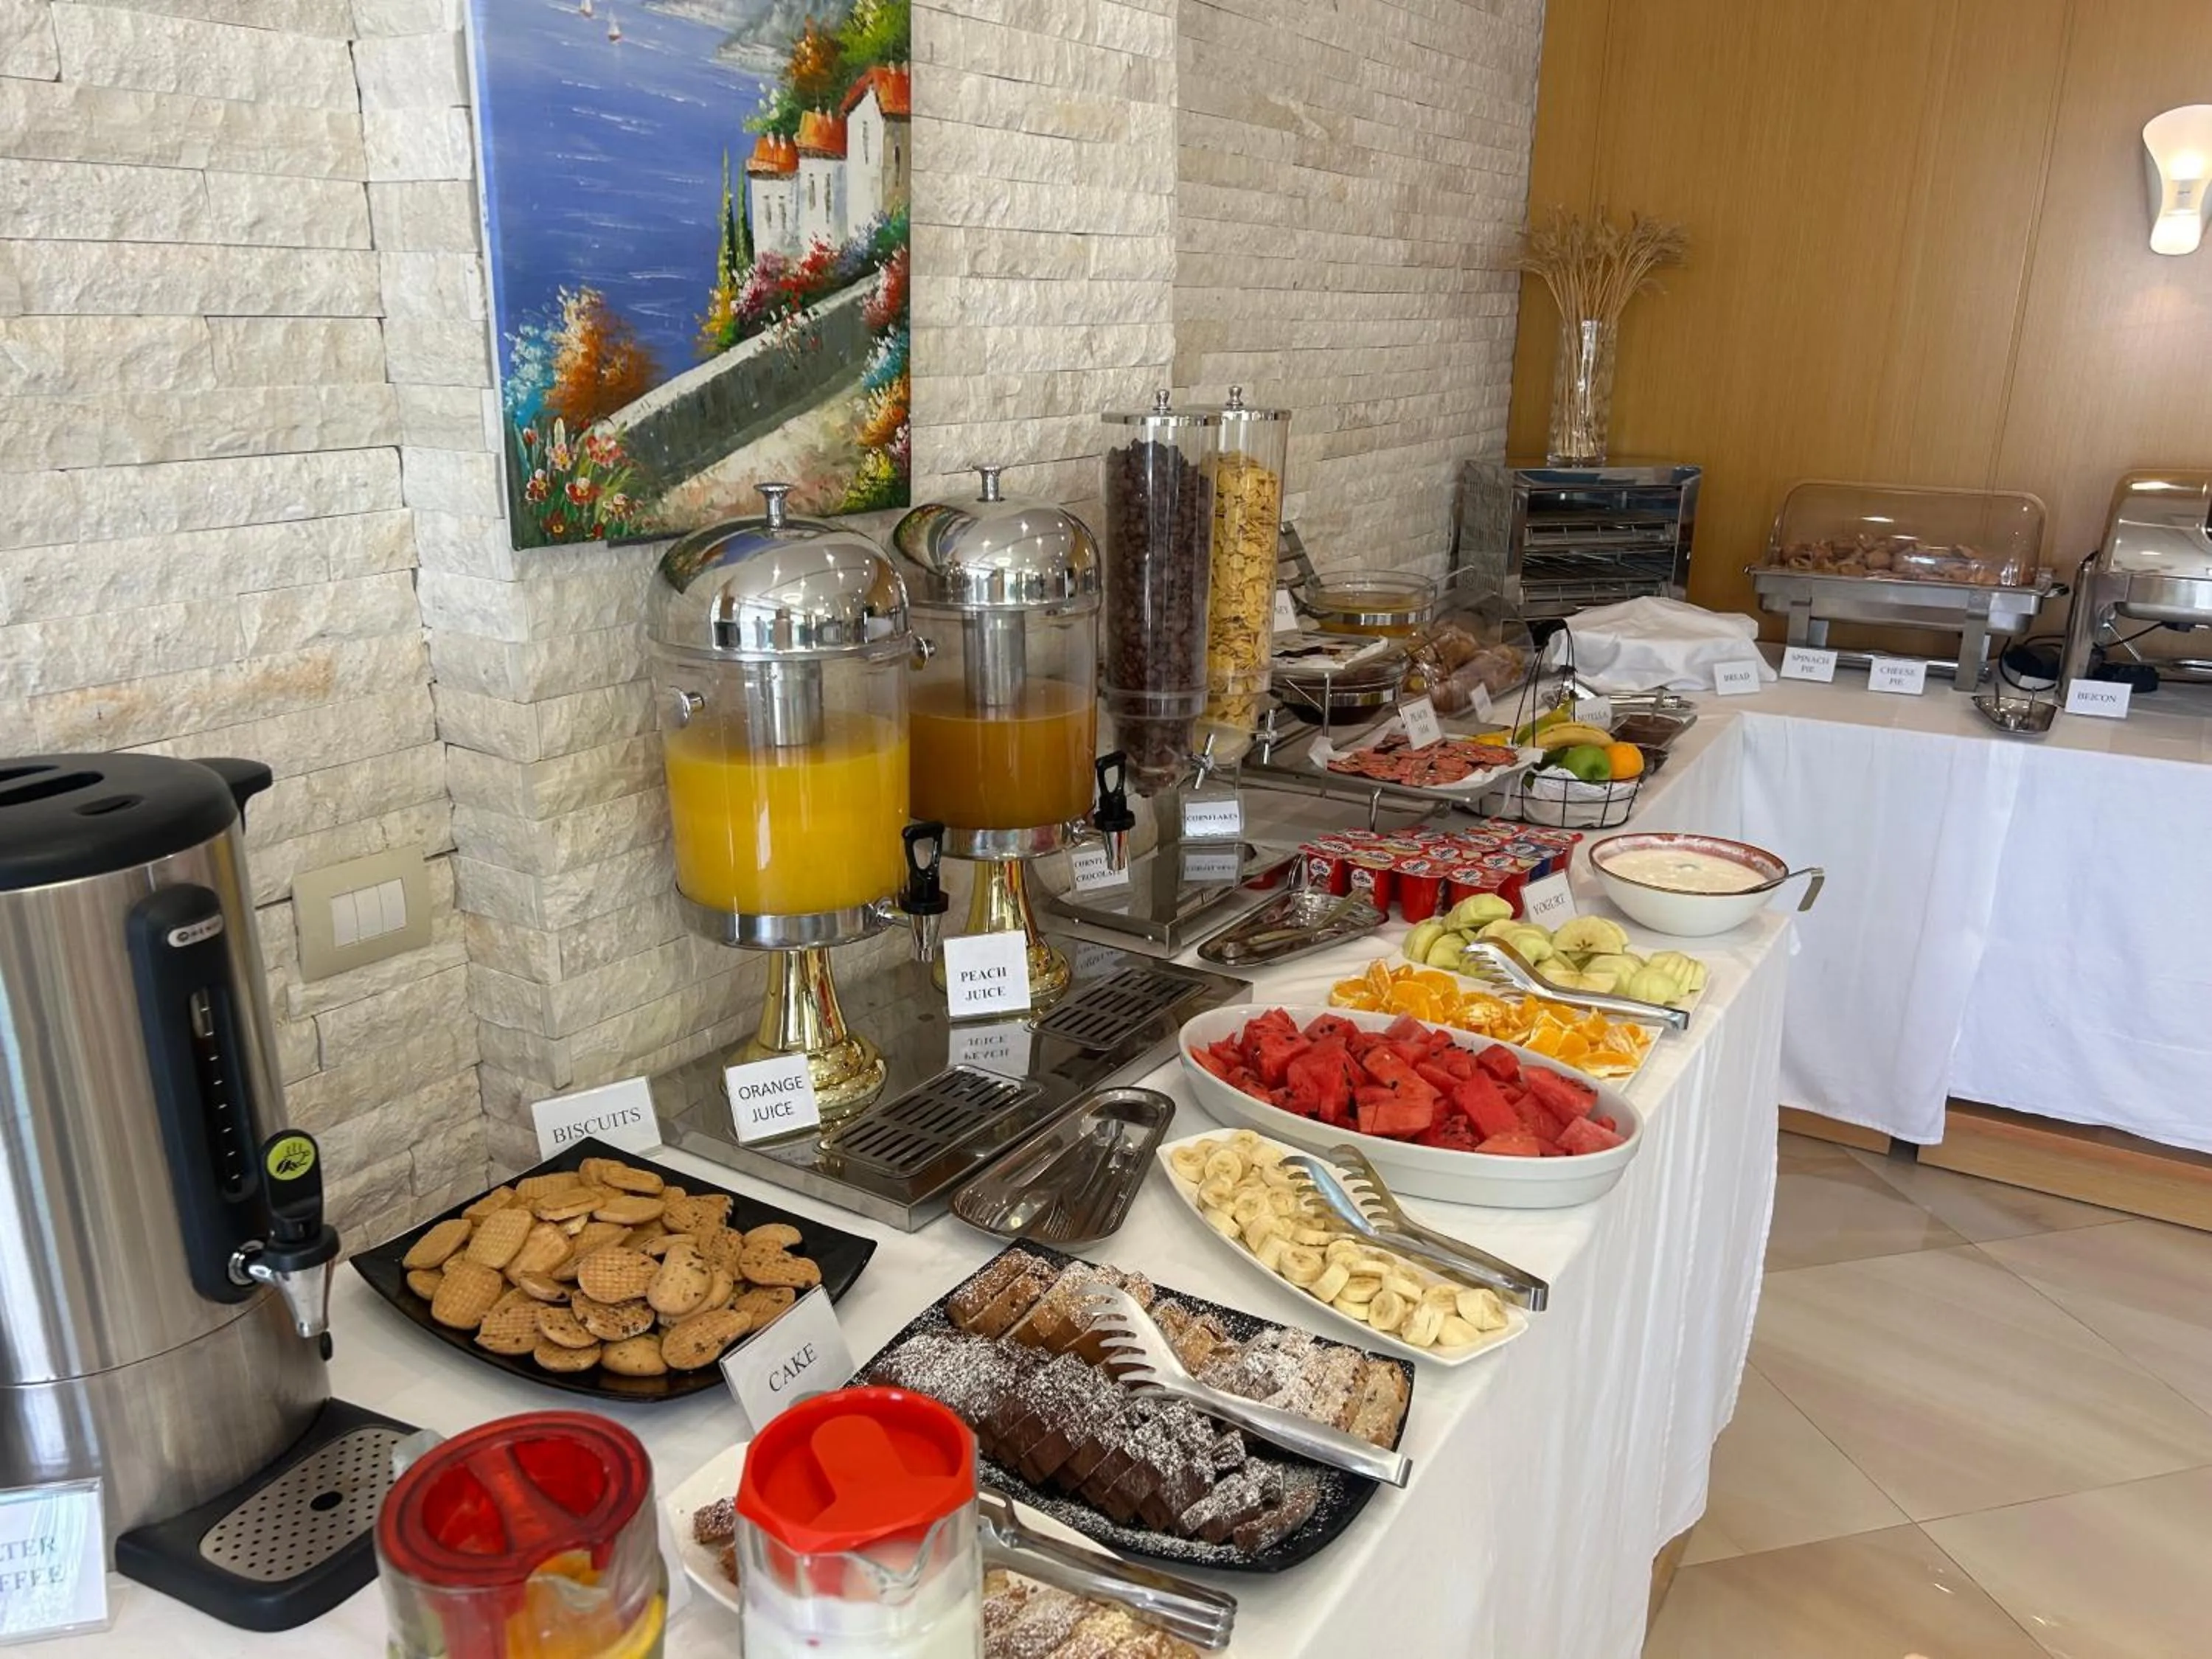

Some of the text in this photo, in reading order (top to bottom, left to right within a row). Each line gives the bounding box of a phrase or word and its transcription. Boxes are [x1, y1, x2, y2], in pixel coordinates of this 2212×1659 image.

[1792, 653, 1830, 664] SPINACH
[1723, 672, 1750, 681] BREAD
[1879, 666, 1915, 675] CHEESE
[1186, 813, 1238, 822] CORNFLAKES
[960, 966, 1007, 983] PEACH
[964, 986, 1006, 1001] JUICE
[738, 1075, 804, 1101] ORANGE
[751, 1101, 795, 1123] JUICE
[552, 1107, 642, 1144] BISCUITS
[768, 1342, 818, 1392] CAKE
[0, 1535, 58, 1562] TER
[0, 1563, 64, 1593] FFEE
